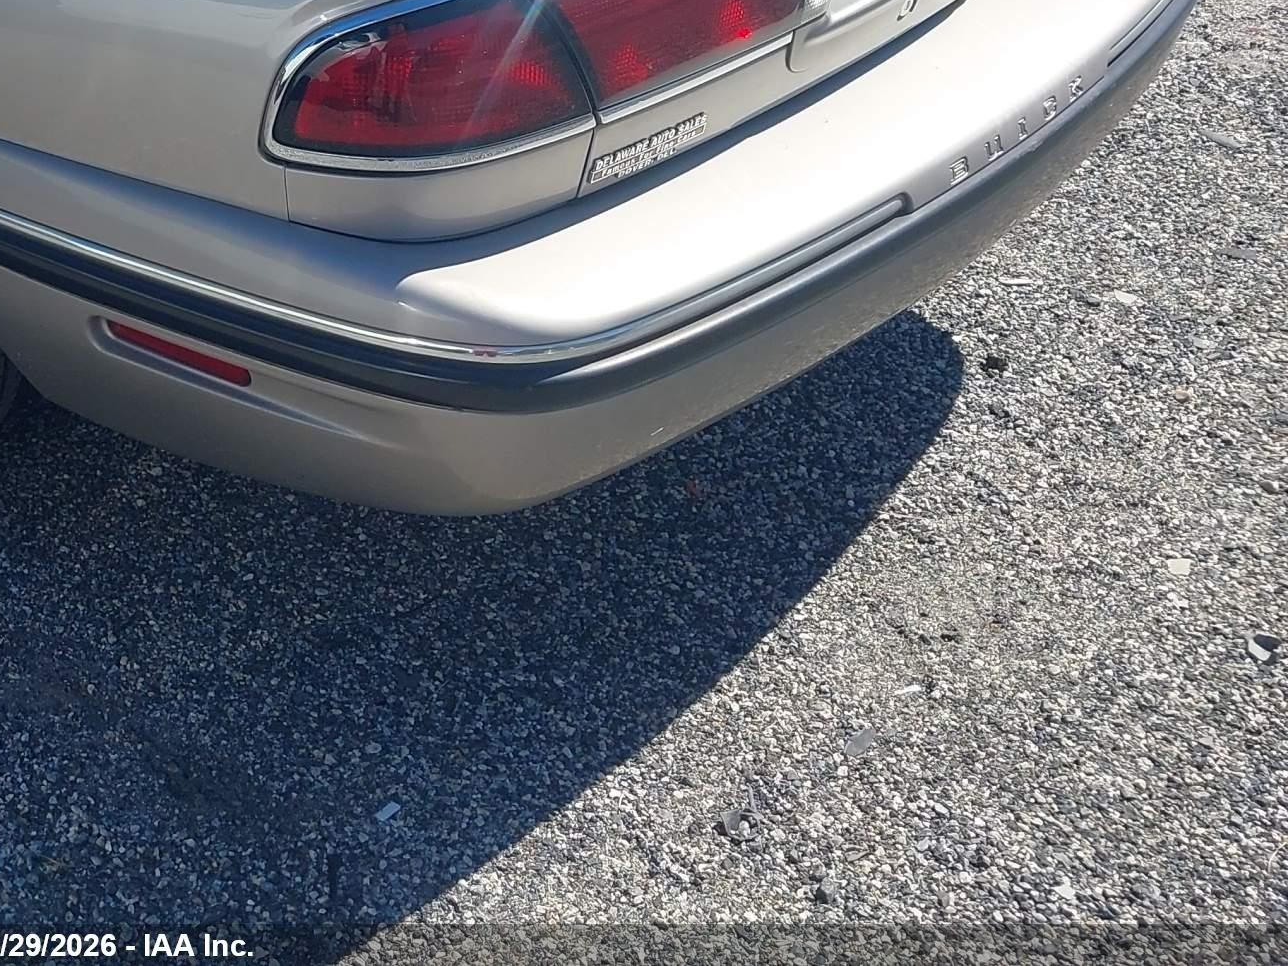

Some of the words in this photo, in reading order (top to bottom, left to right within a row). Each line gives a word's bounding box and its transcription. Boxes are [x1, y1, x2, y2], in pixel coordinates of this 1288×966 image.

[595, 137, 650, 171] DELAWARE
[651, 128, 676, 148] AUTO
[677, 114, 707, 136] SALES
[949, 75, 1085, 186] BUICK
